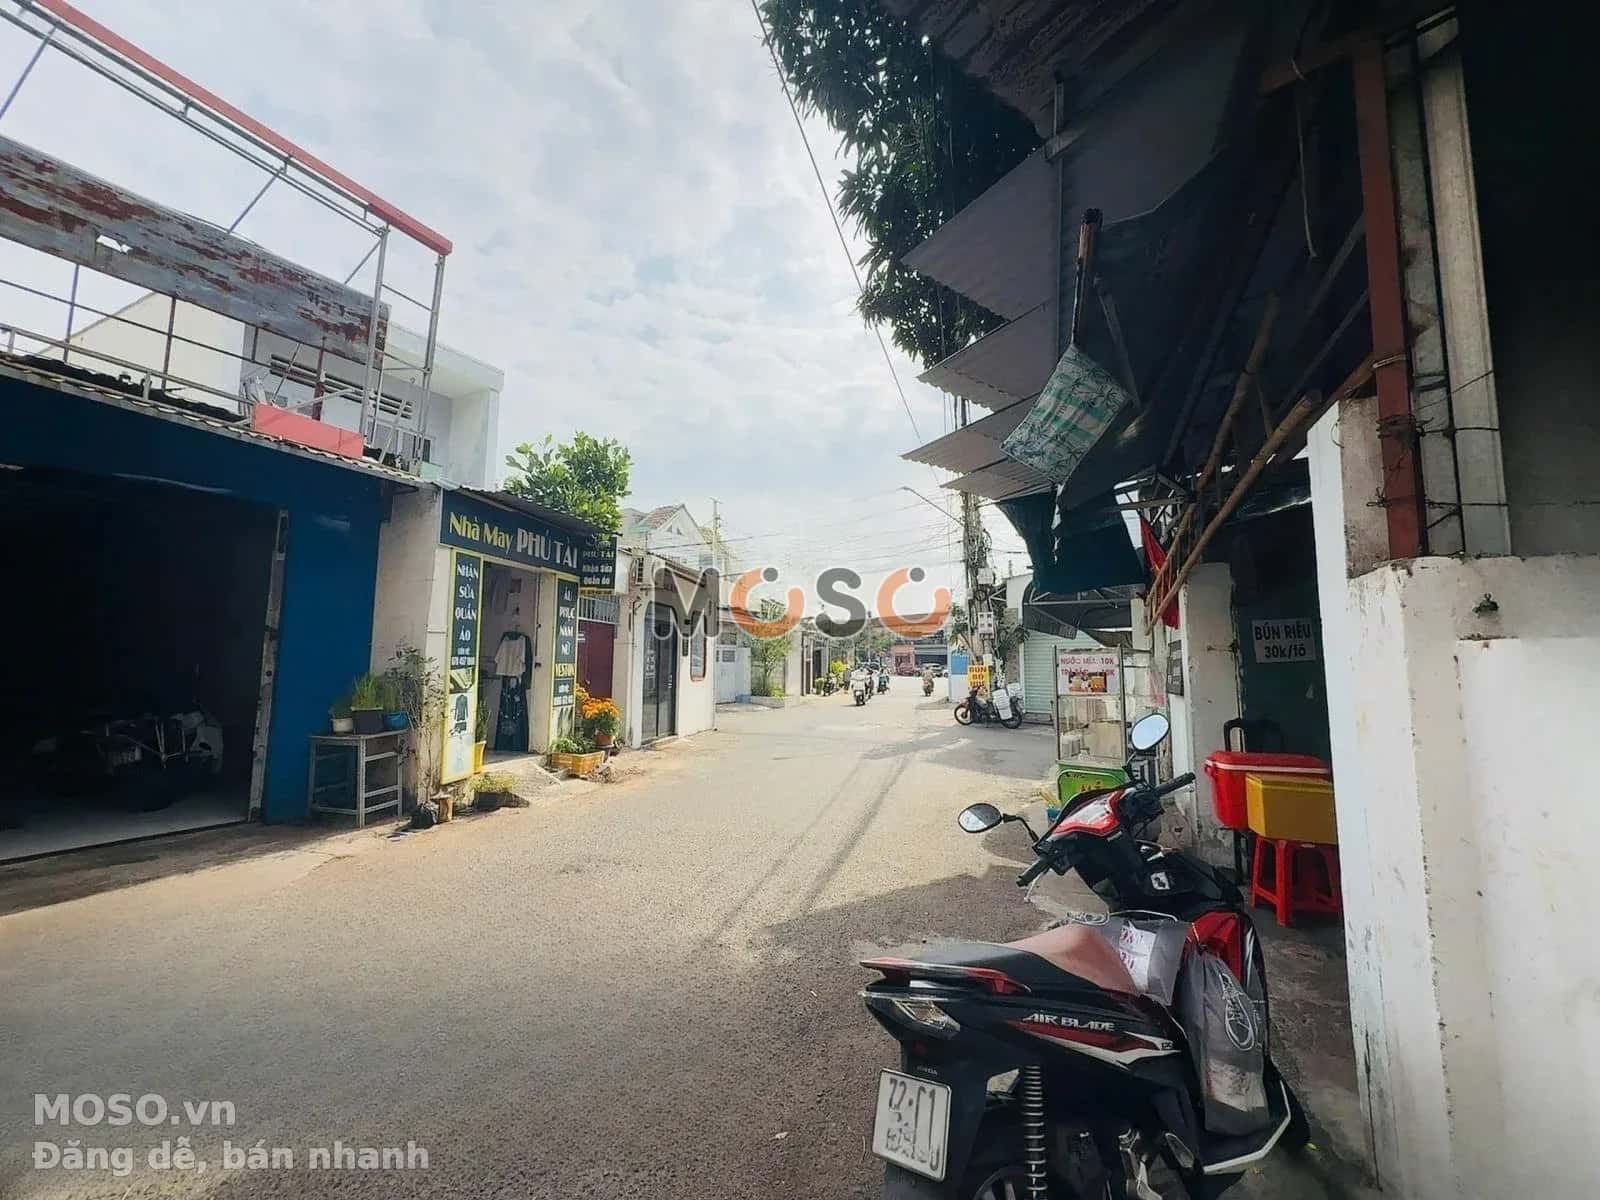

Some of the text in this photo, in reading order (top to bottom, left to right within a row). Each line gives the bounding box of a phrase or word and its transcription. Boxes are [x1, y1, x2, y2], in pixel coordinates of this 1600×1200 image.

[449, 512, 479, 541] Nhà
[483, 523, 513, 554] May
[516, 529, 551, 561] PHÚ
[553, 537, 578, 569] TÀI
[1254, 622, 1281, 641] BÚN
[1022, 1009, 1116, 1032] AIR BLADE
